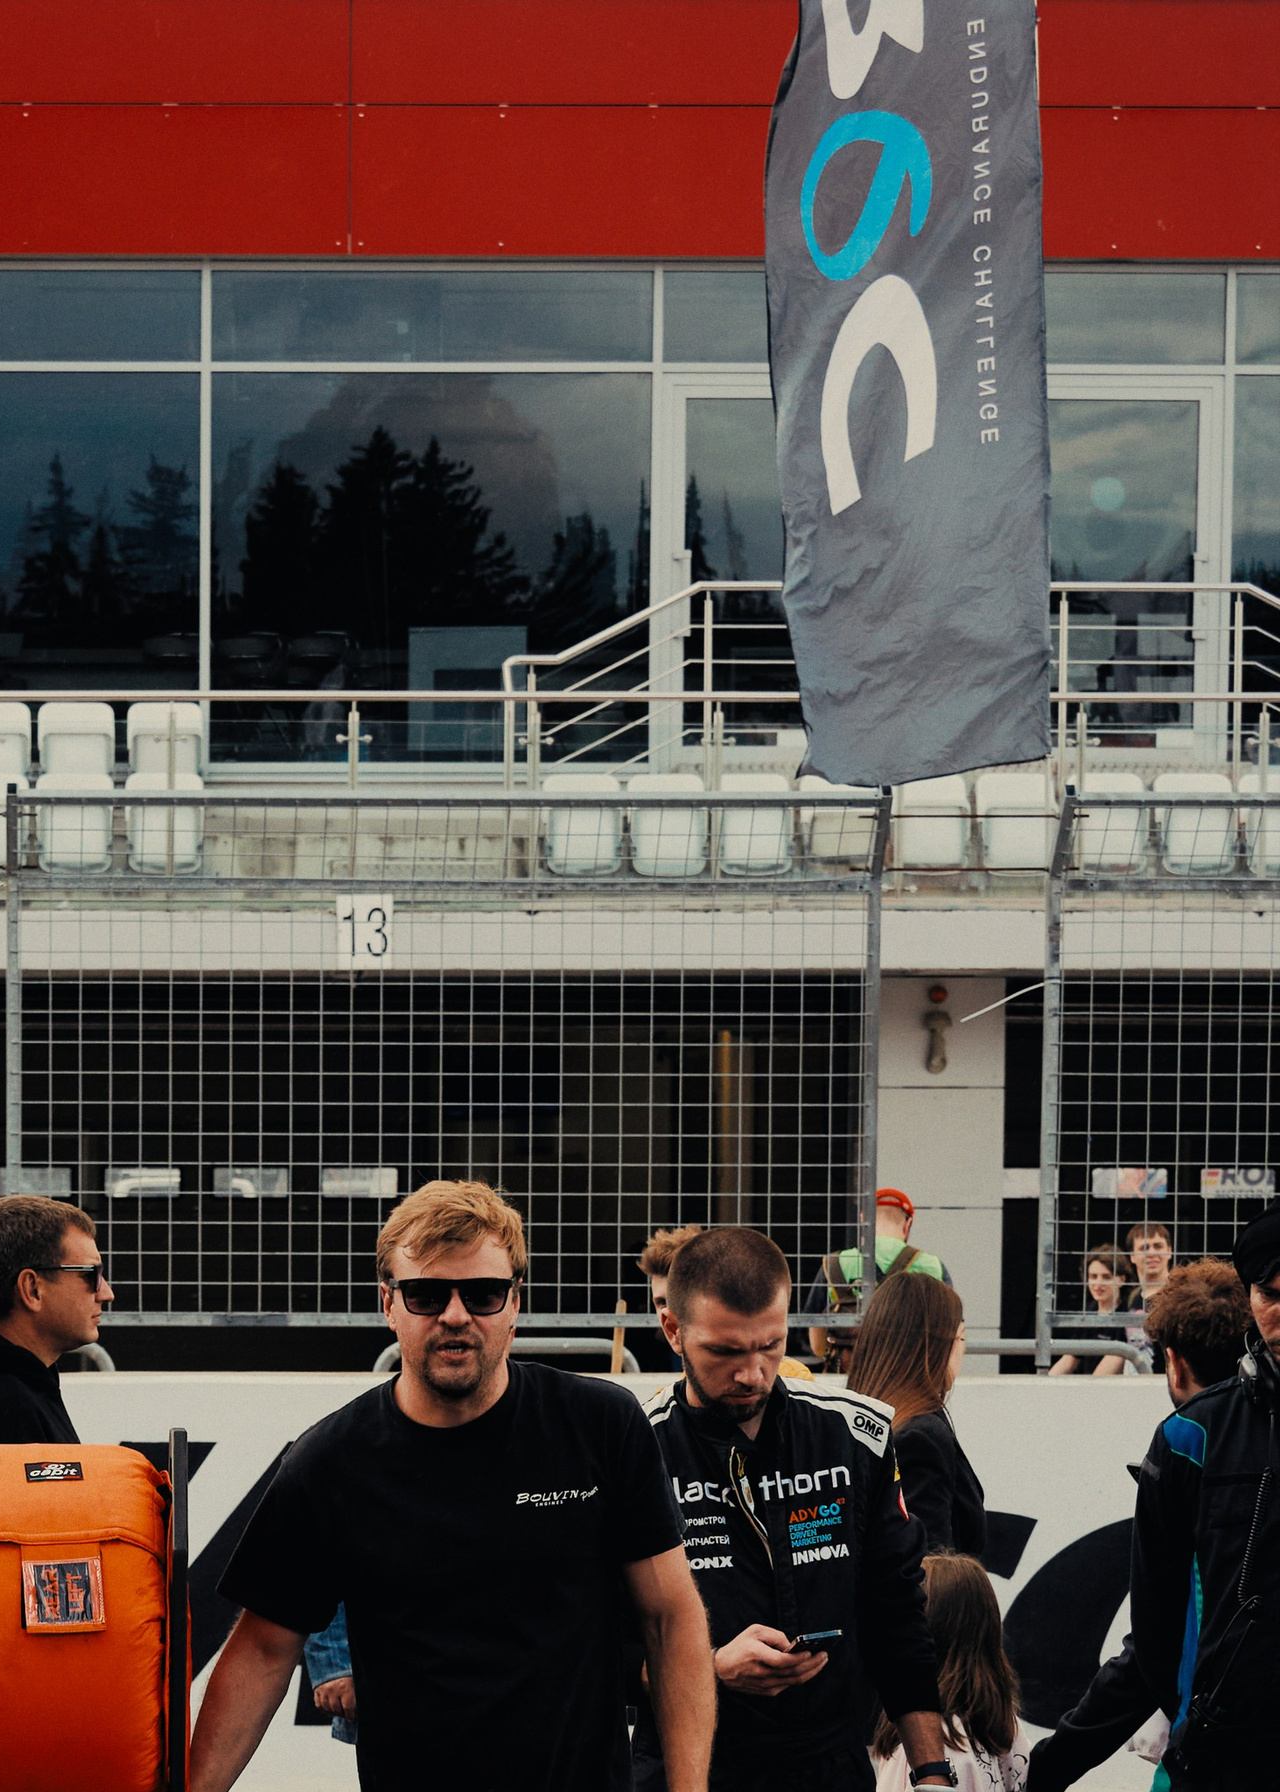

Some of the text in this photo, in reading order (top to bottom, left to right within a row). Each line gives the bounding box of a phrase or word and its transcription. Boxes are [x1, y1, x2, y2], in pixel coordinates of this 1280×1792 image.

[342, 907, 388, 957] 13
[853, 1415, 884, 1438] OMP
[516, 1489, 579, 1505] BOUVIN
[673, 1476, 736, 1508] lack
[788, 1516, 843, 1532] PERFORMANCE
[790, 1528, 817, 1540] DRIVEN
[791, 1533, 832, 1548] MARKETING
[792, 1543, 850, 1566] INNOVA
[42, 1567, 61, 1618] REAR
[66, 1572, 84, 1612] LEFT
